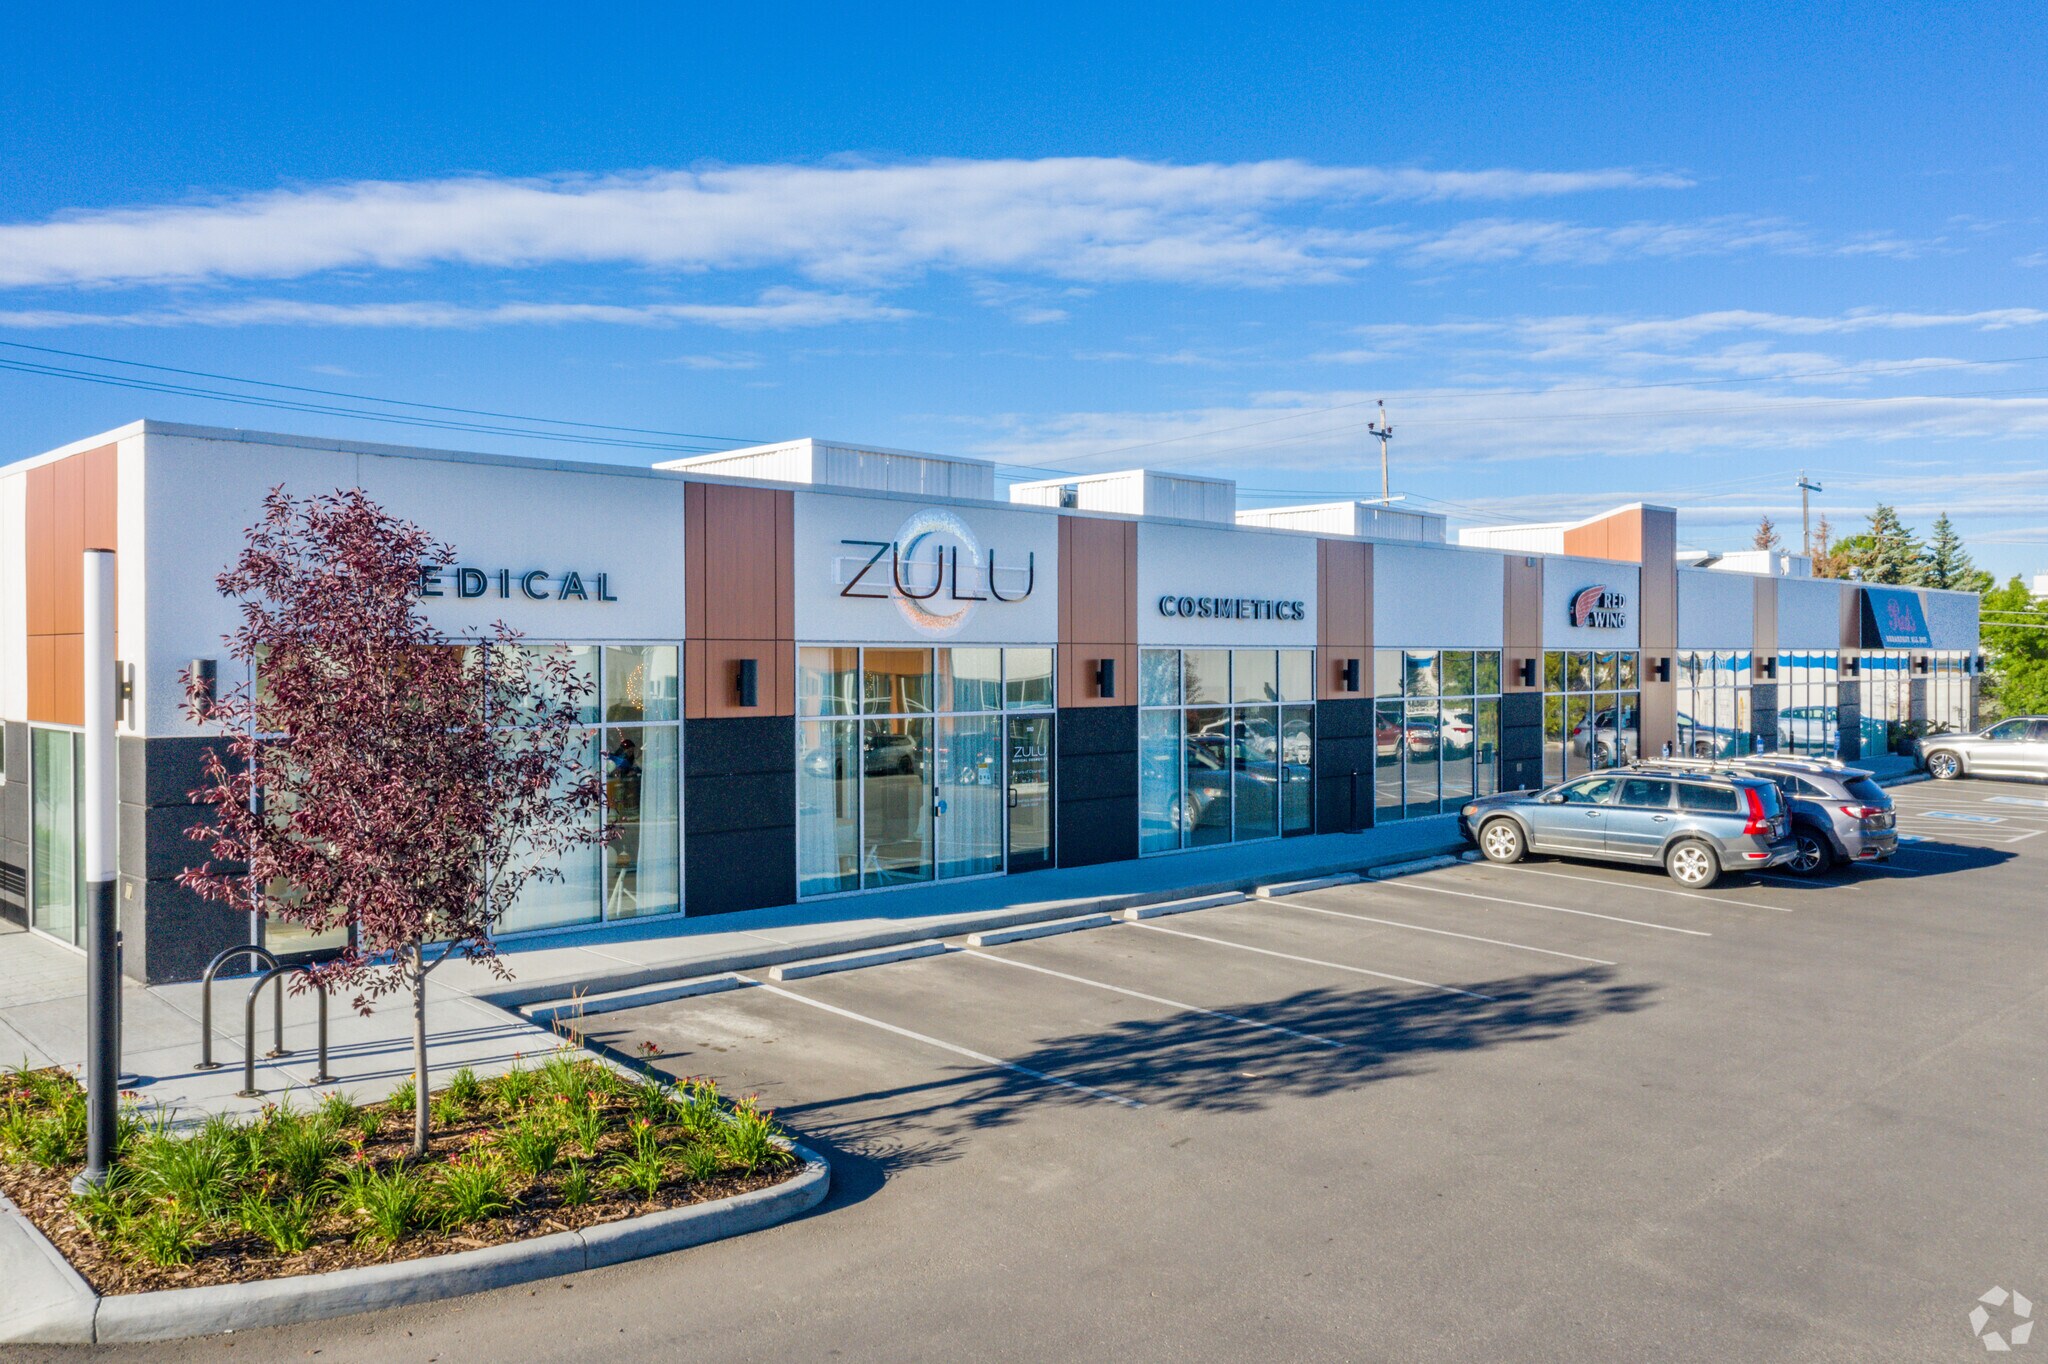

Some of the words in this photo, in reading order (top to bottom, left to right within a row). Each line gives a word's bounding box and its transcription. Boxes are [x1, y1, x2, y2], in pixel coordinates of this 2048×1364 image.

[840, 539, 1034, 602] ZULU
[416, 565, 618, 602] EDICAL
[1159, 595, 1305, 621] COSMETICS
[1604, 593, 1626, 608] RED
[1593, 612, 1626, 628] WING
[1014, 746, 1047, 758] ZULU
